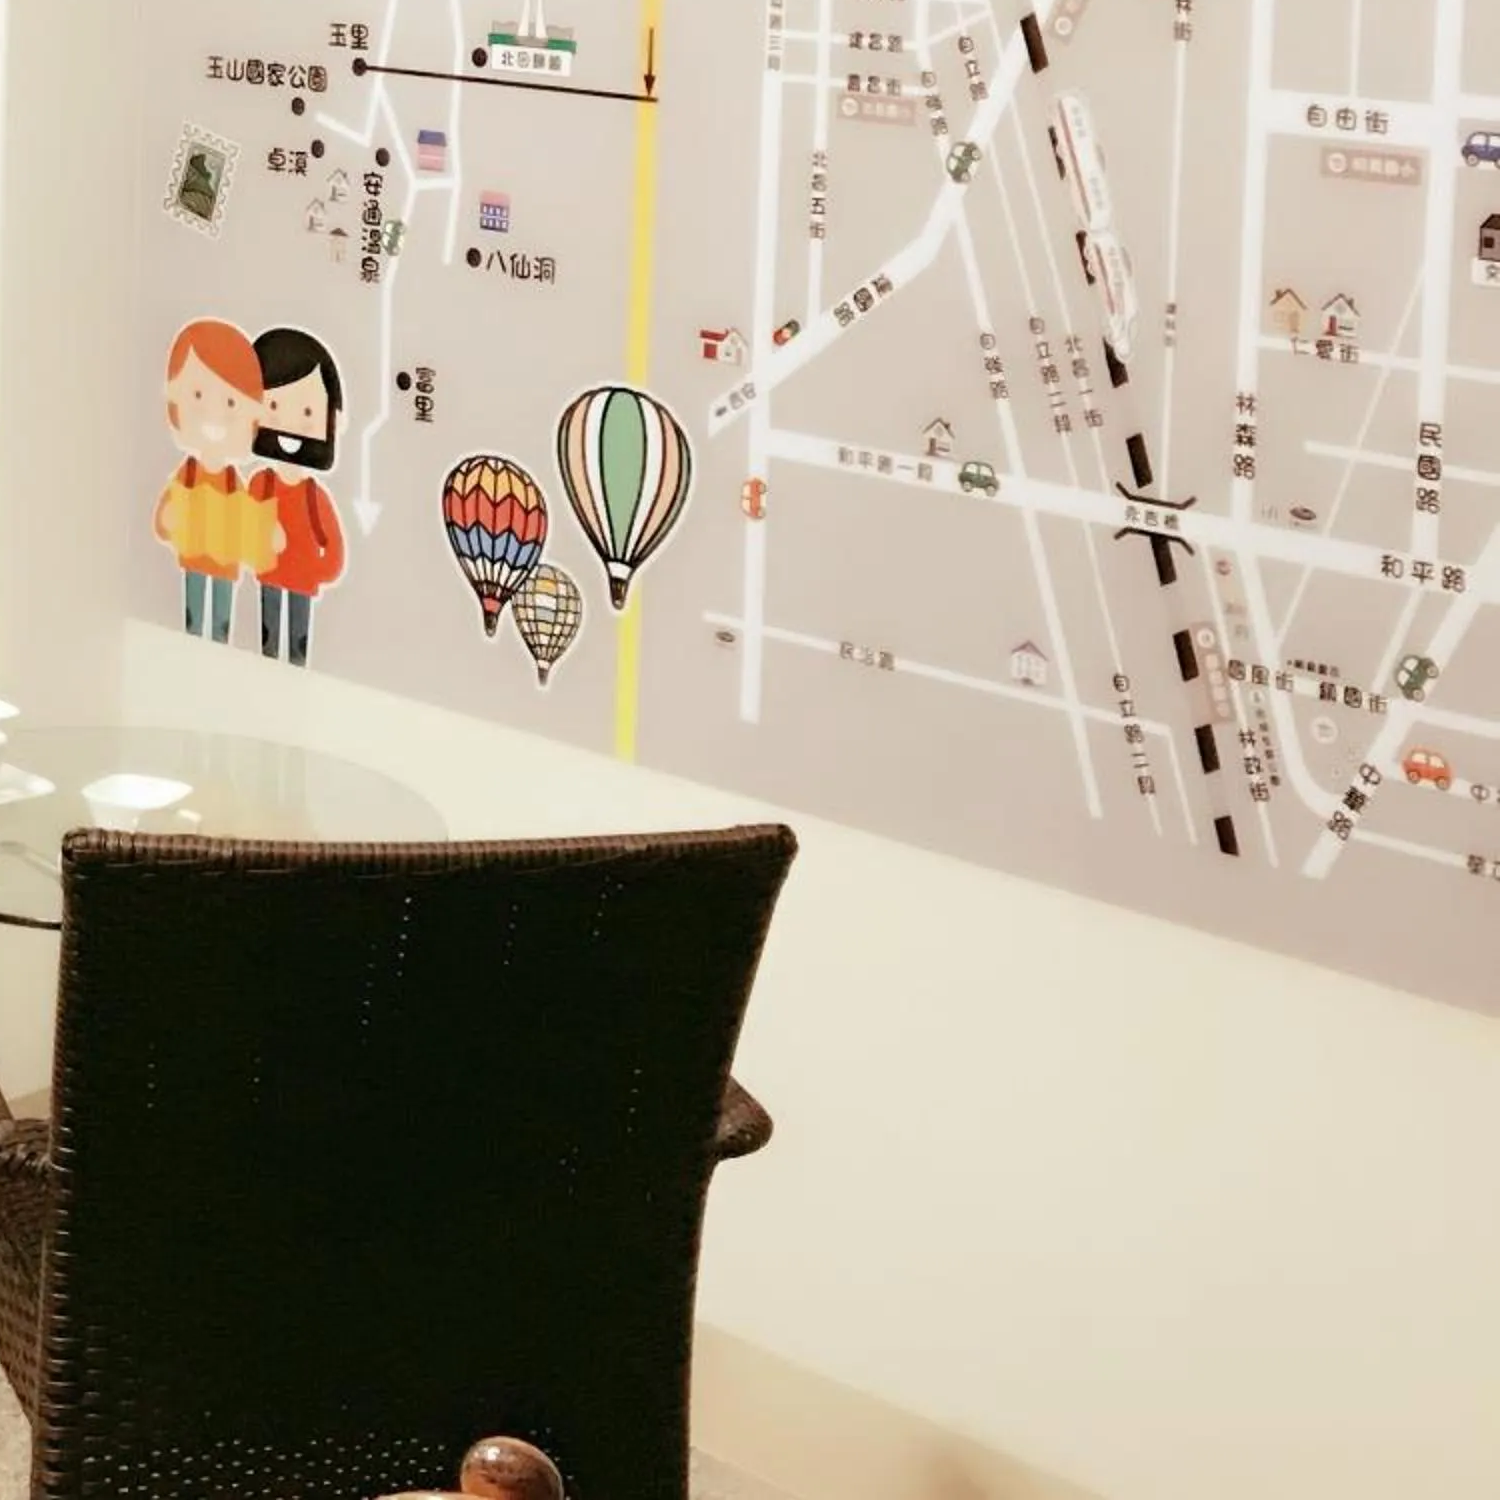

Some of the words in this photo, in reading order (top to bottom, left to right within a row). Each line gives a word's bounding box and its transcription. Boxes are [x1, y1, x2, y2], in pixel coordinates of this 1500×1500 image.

[207, 55, 329, 93] 玉山國家公園
[1306, 103, 1390, 136] 自由街
[486, 250, 556, 285] 八仙洞
[1233, 390, 1259, 481] 林森路
[1415, 421, 1444, 515] 民國路
[1380, 553, 1467, 595] 和平路
